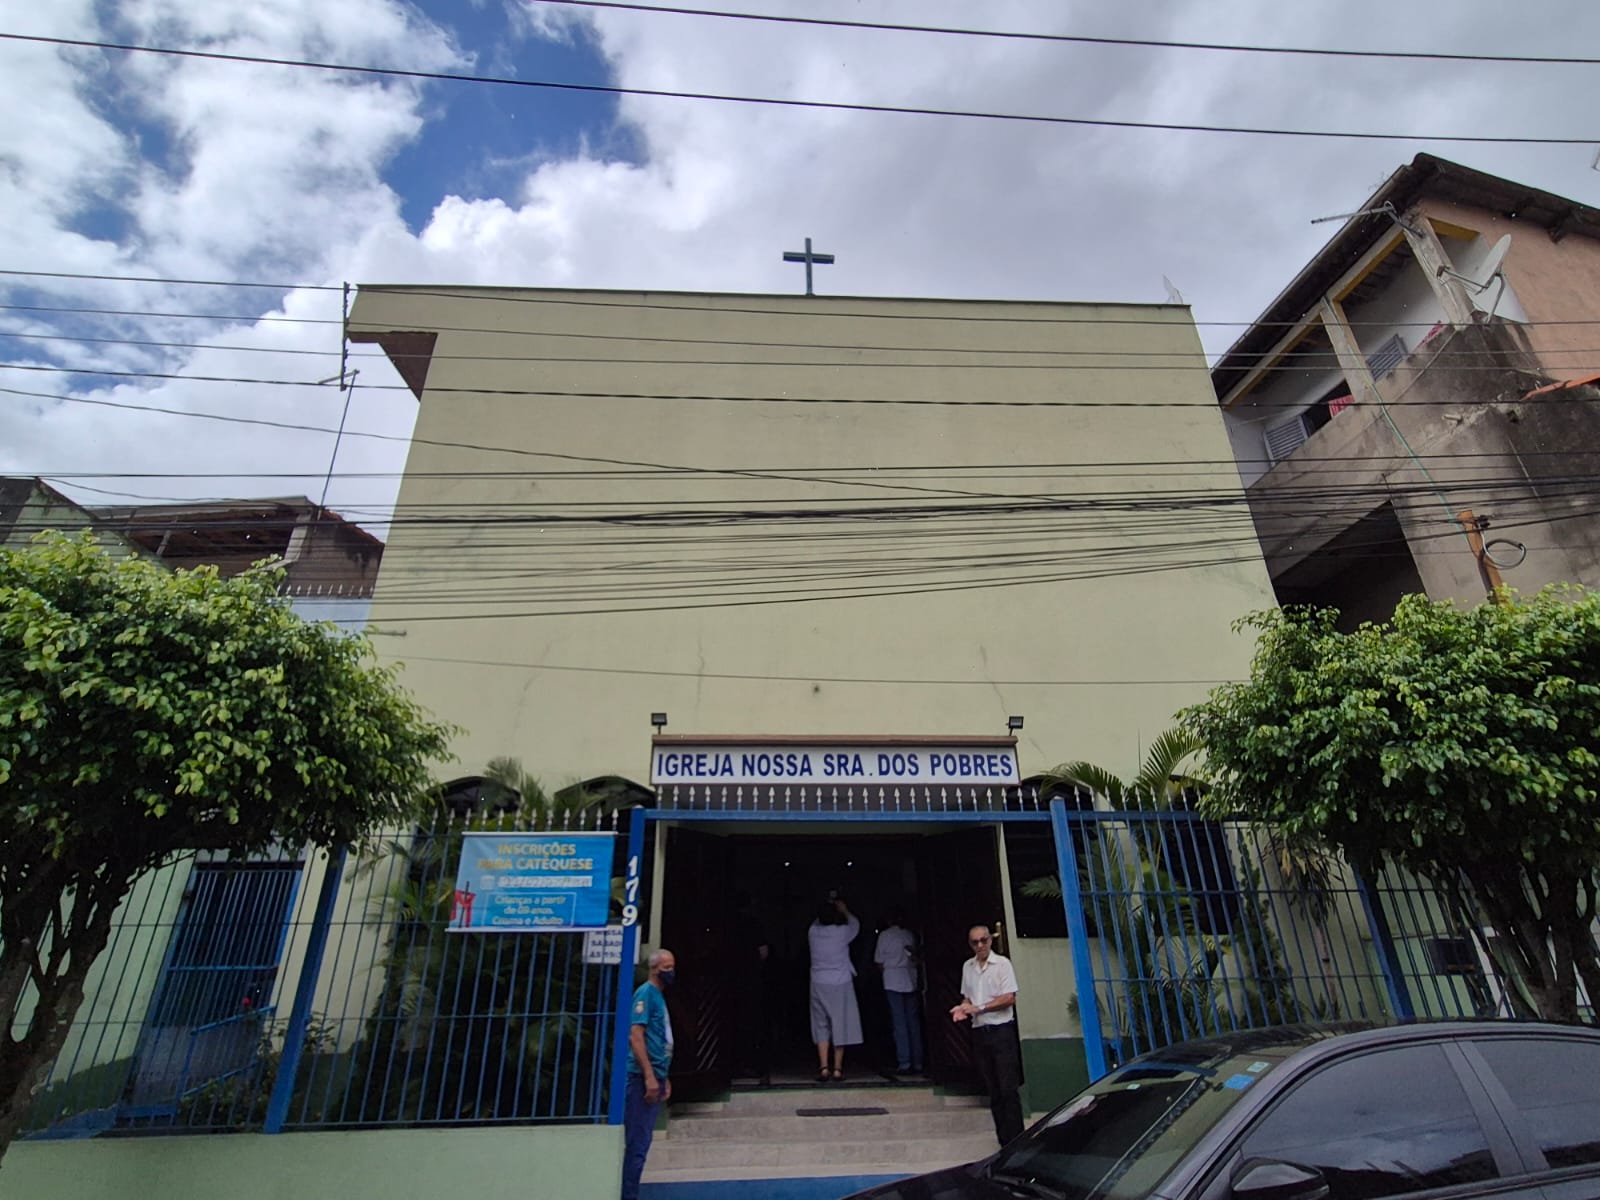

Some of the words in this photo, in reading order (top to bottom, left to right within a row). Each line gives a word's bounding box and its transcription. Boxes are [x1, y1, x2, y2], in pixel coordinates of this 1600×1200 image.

[657, 753, 734, 777] IGREJA
[741, 753, 813, 777] NOSSA
[877, 753, 920, 776] DOS
[929, 753, 1013, 777] POBRES
[622, 855, 639, 926] 179
